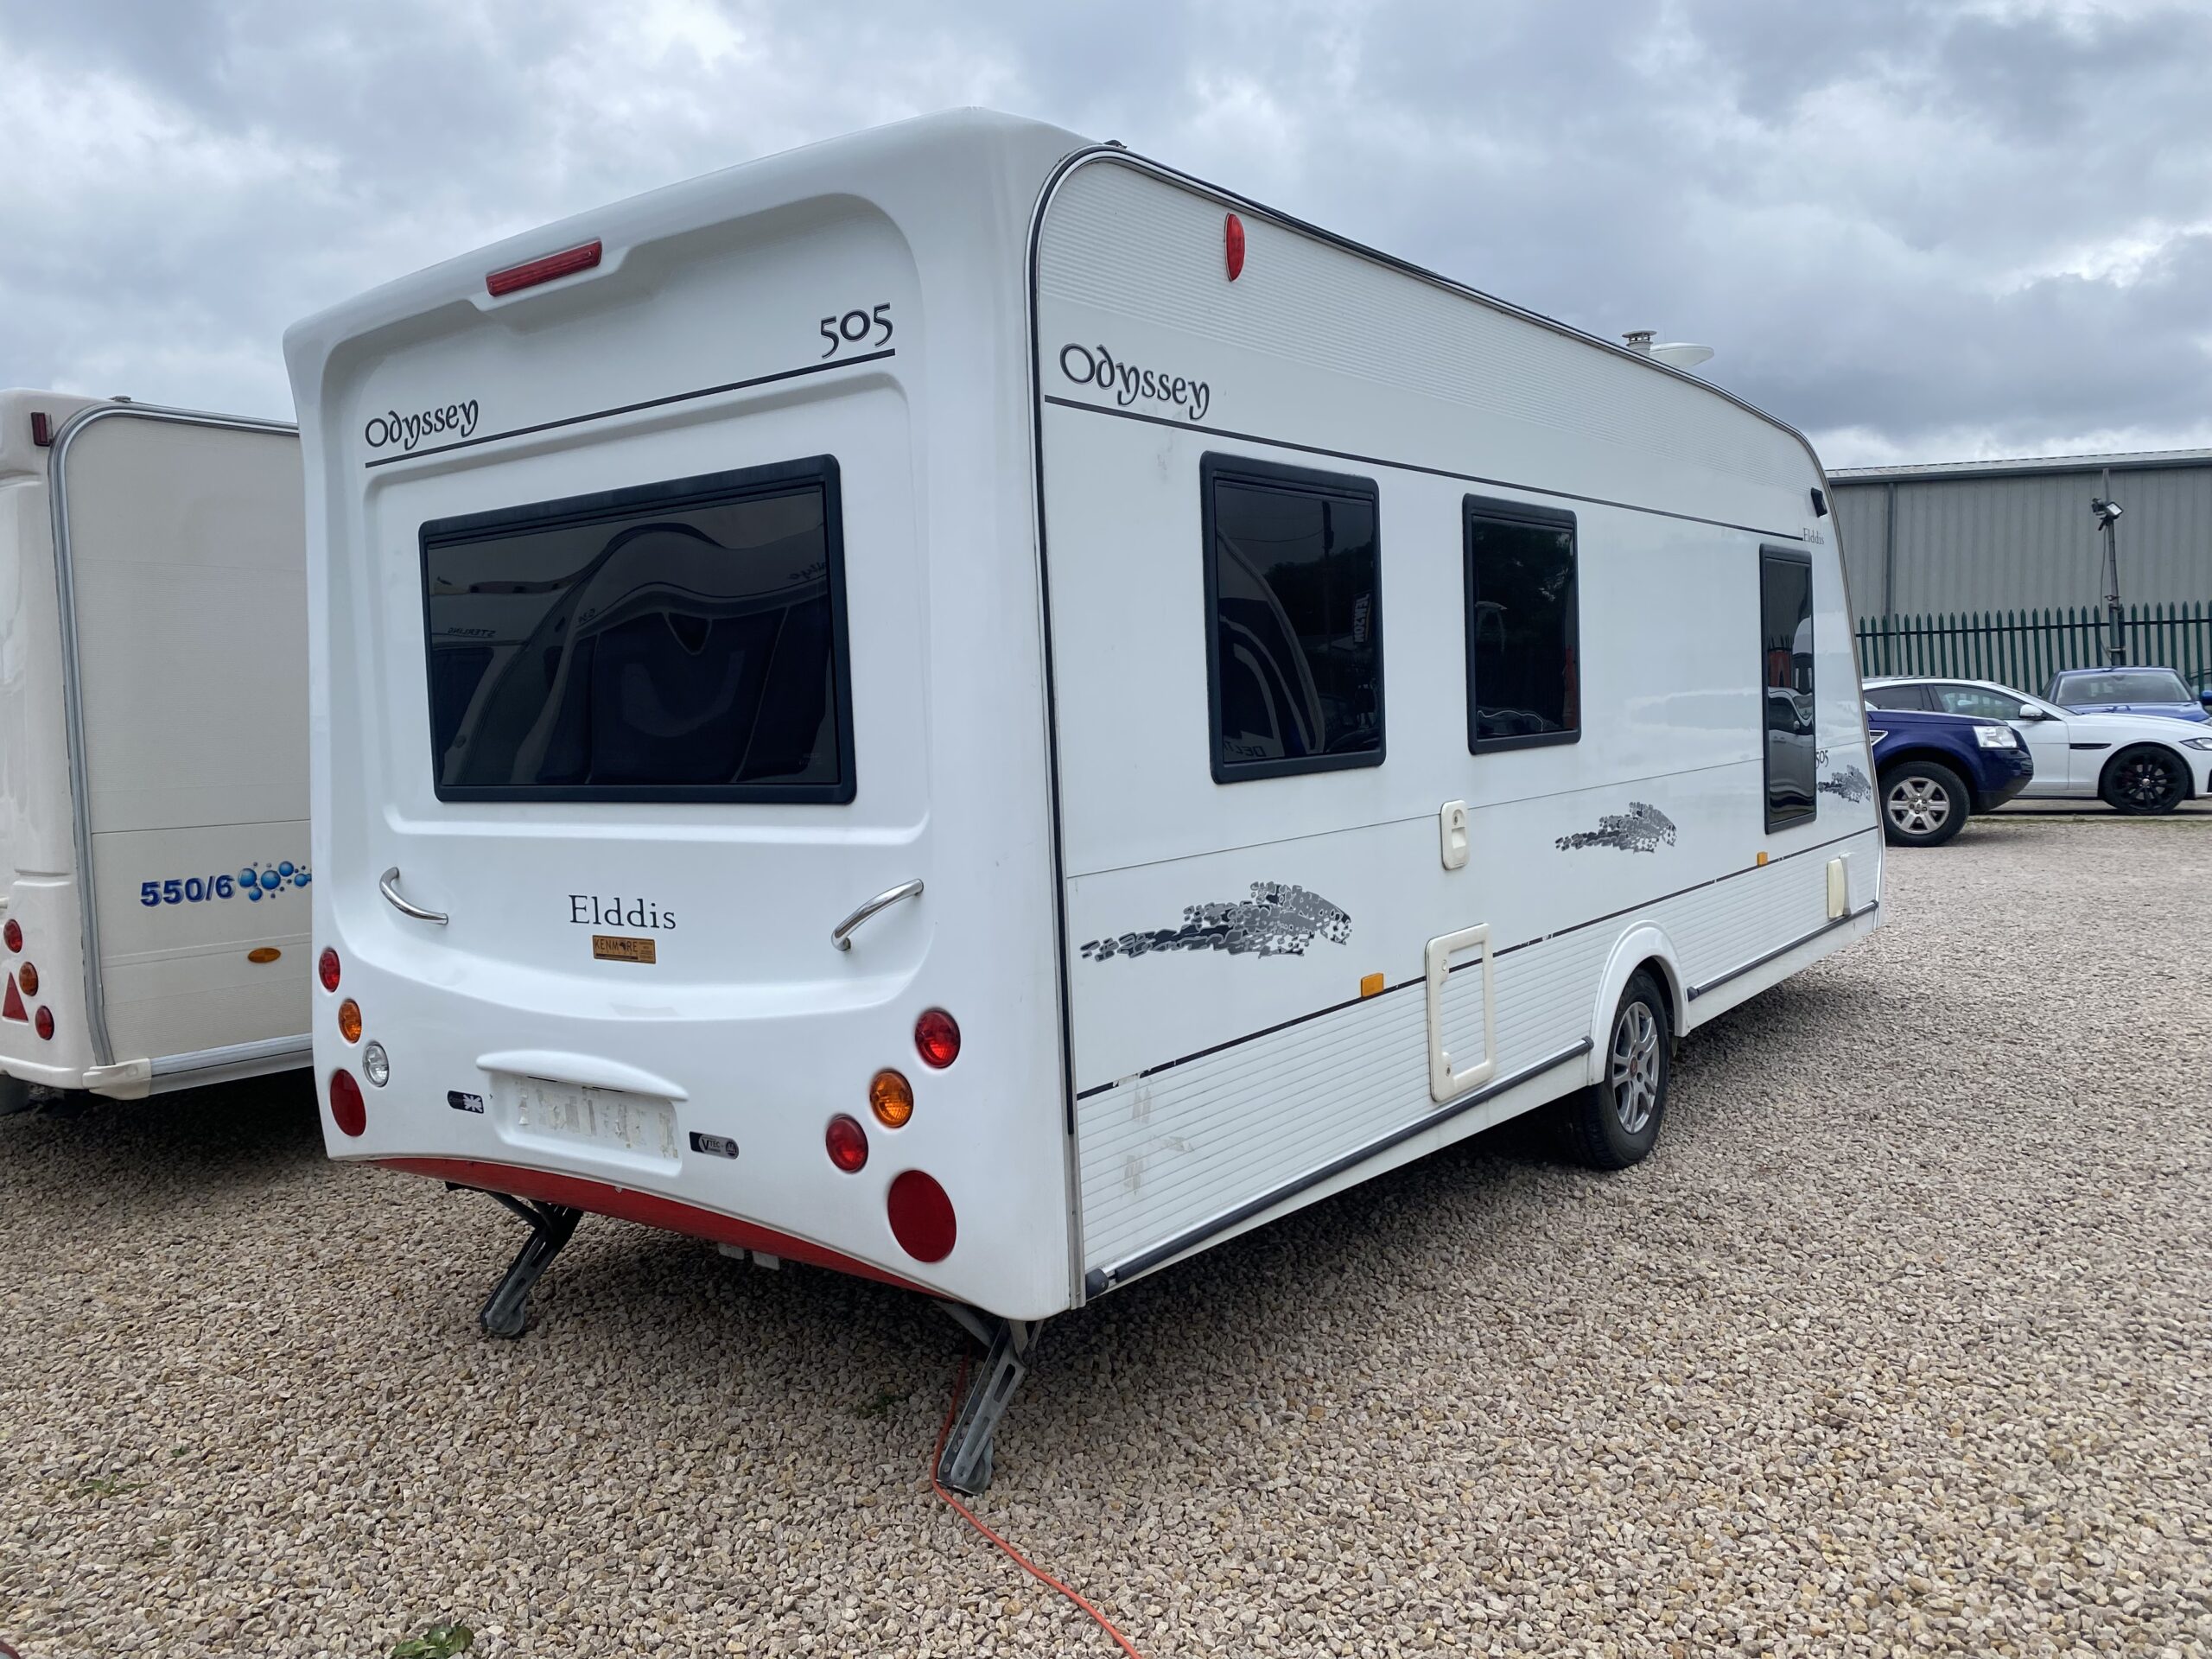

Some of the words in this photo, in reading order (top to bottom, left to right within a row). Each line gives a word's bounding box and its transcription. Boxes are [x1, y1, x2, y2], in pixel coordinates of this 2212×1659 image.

[820, 302, 894, 359] 505
[1059, 343, 1210, 420] Odyssey
[365, 398, 479, 451] Odyssey
[1803, 528, 1825, 544] Elddis
[140, 874, 235, 906] 550/6
[569, 894, 677, 930] Elddis
[594, 938, 638, 952] KENMRE
